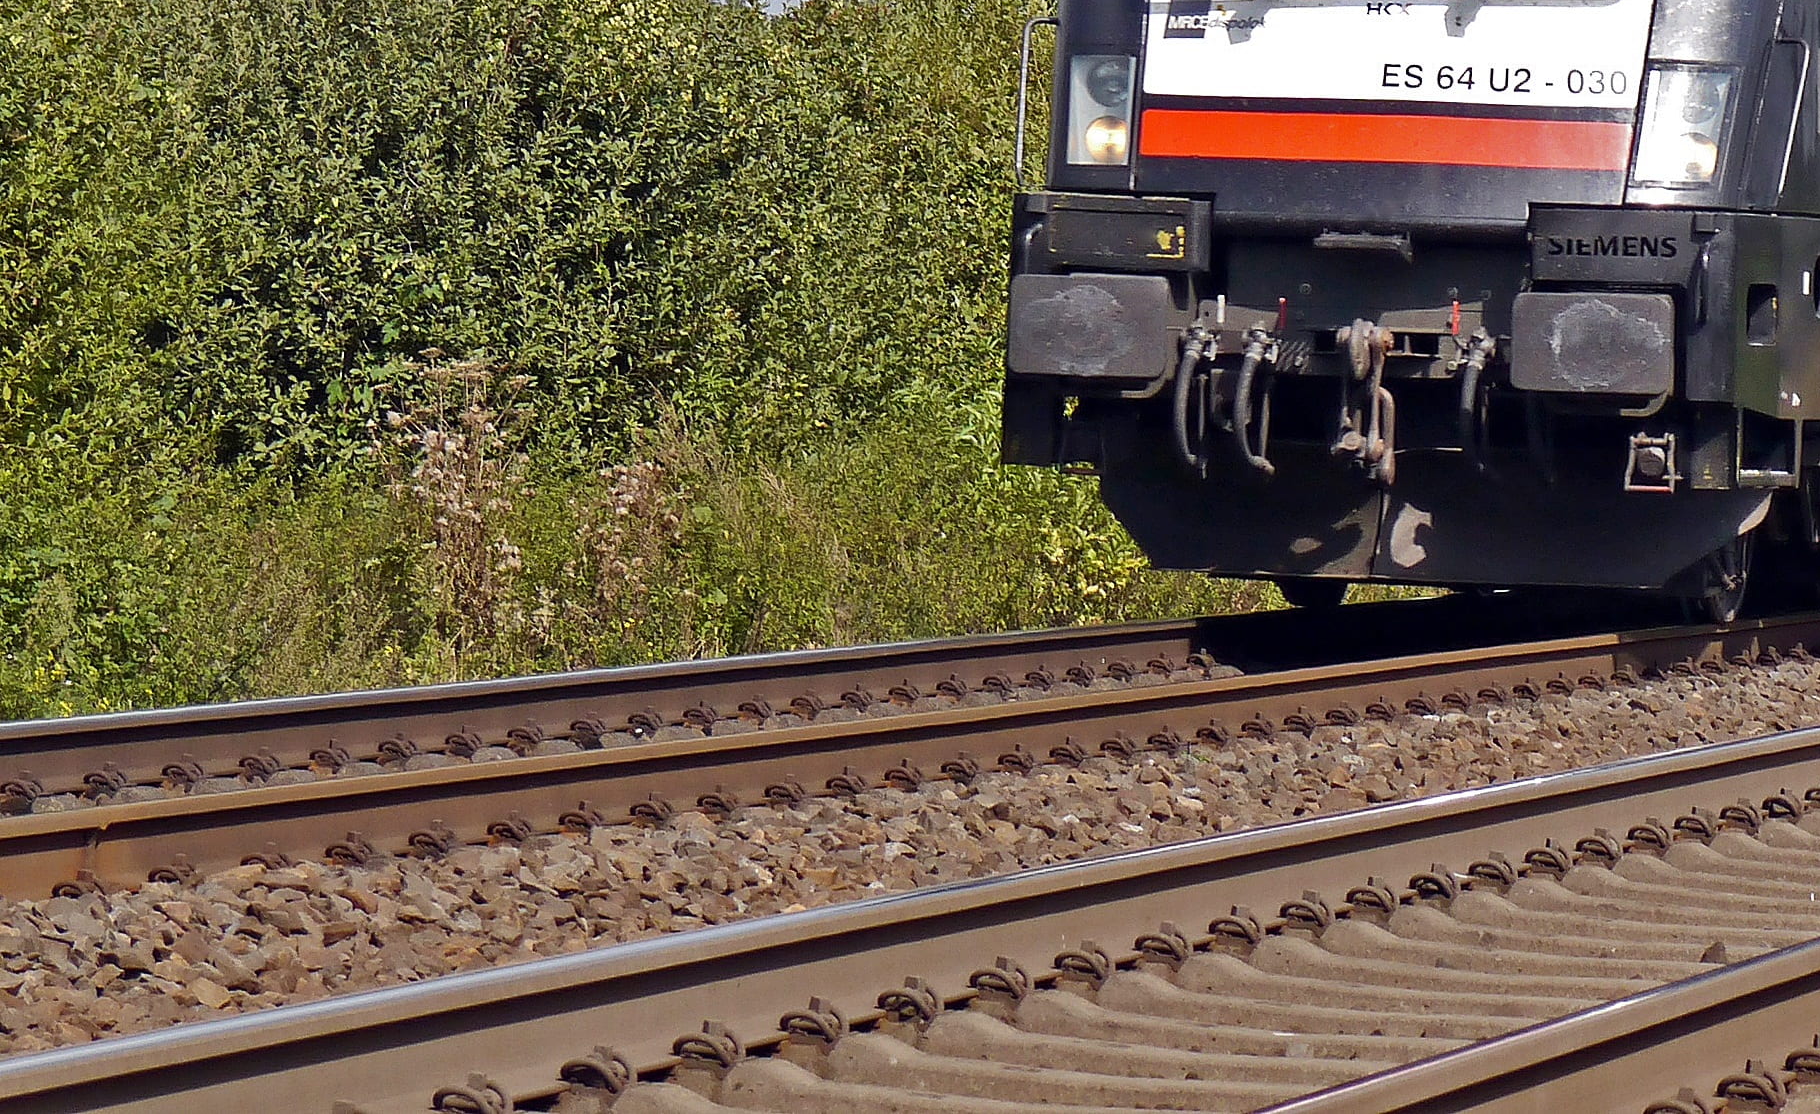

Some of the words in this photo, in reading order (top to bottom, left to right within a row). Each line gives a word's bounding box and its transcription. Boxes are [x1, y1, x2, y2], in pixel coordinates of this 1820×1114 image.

[1382, 63, 1424, 88] ES
[1436, 65, 1475, 90] 64
[1489, 67, 1531, 92] U2
[1567, 69, 1627, 94] 030
[1548, 236, 1677, 258] SIEMENS
